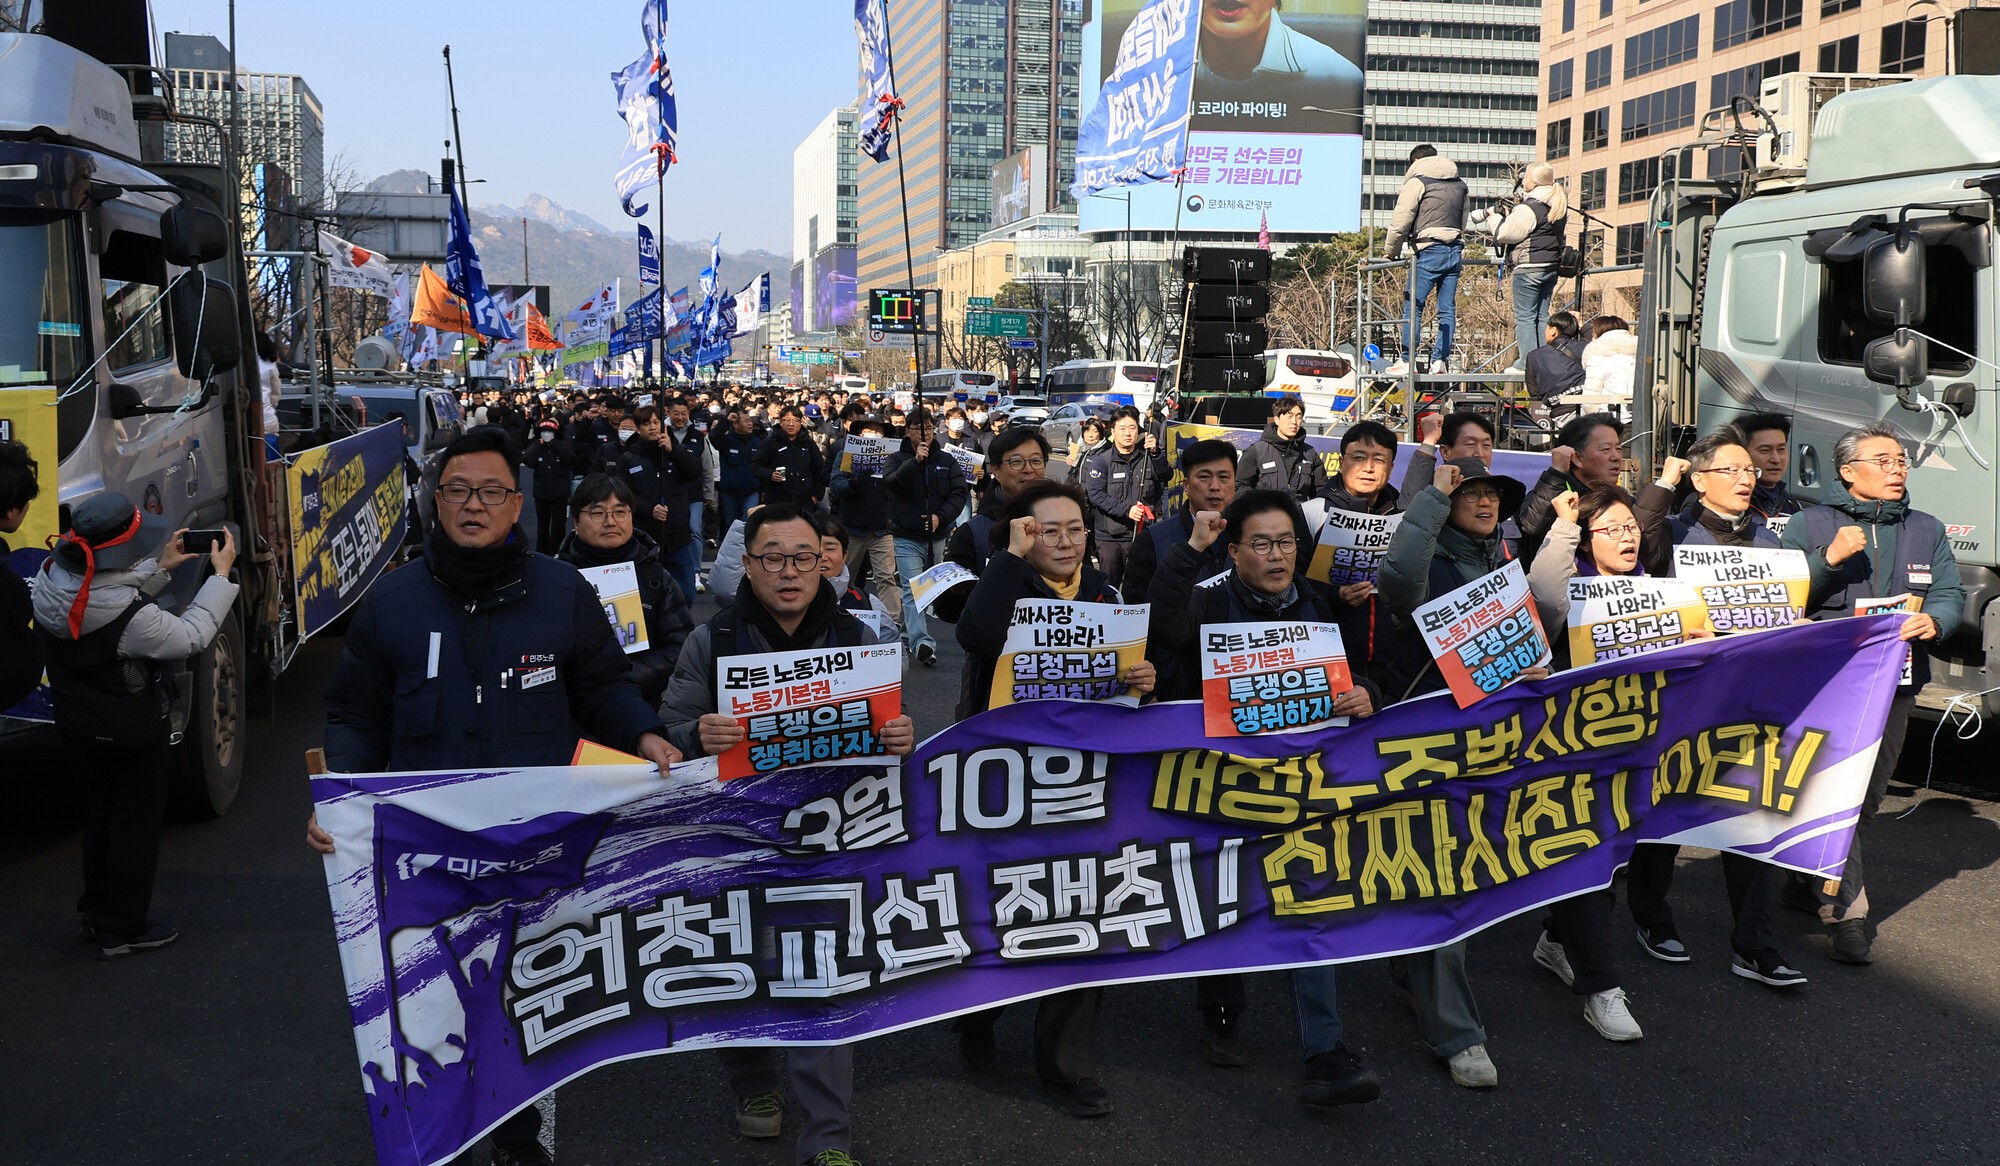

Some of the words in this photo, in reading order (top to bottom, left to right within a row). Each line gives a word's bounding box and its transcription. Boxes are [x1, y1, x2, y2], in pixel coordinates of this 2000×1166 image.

[1198, 101, 1239, 117] 코리아
[1241, 102, 1287, 118] 파이팅!
[1234, 147, 1303, 165] 선수들의
[1216, 168, 1303, 185] 기원합니다
[1208, 199, 1272, 211] 문화체육관광부
[1001, 317, 1020, 325] 청계1가
[1329, 511, 1387, 533] 진짜사장
[1679, 549, 1742, 567] 진짜사장
[1953, 540, 1980, 551] TON
[1714, 563, 1773, 582] 나와라!
[1421, 606, 1457, 634] 모든
[1453, 571, 1509, 616] 노동자의
[1569, 579, 1634, 600] 진짜사장
[1701, 582, 1788, 606] 원청교섭
[1607, 590, 1666, 617] 나와라!
[1435, 598, 1506, 651] 노동기본권
[1592, 611, 1681, 648] 원청교섭
[1708, 606, 1804, 631] 쟁취하자!
[1034, 624, 1104, 648] 나와라!
[1207, 632, 1244, 653] 모든
[1248, 625, 1310, 649] 노동자의
[1457, 605, 1535, 668] 투쟁으로
[530, 654, 555, 662] 민주노총
[725, 667, 769, 689] 모든
[774, 651, 854, 684] 노동자의
[871, 649, 896, 657] 민주노총
[1013, 651, 1117, 681] 원청교섭
[1213, 648, 1295, 675] 노동기본권
[732, 679, 831, 715] 노동기본권
[1229, 667, 1329, 703] 투쟁으로
[749, 700, 870, 742] 투쟁으로
[928, 747, 1108, 832] 10일
[1524, 670, 1666, 762] 시행!
[511, 874, 971, 1057] 원청교섭
[995, 838, 1243, 959] 쟁취!
[1263, 773, 1600, 916] 진짜사장
